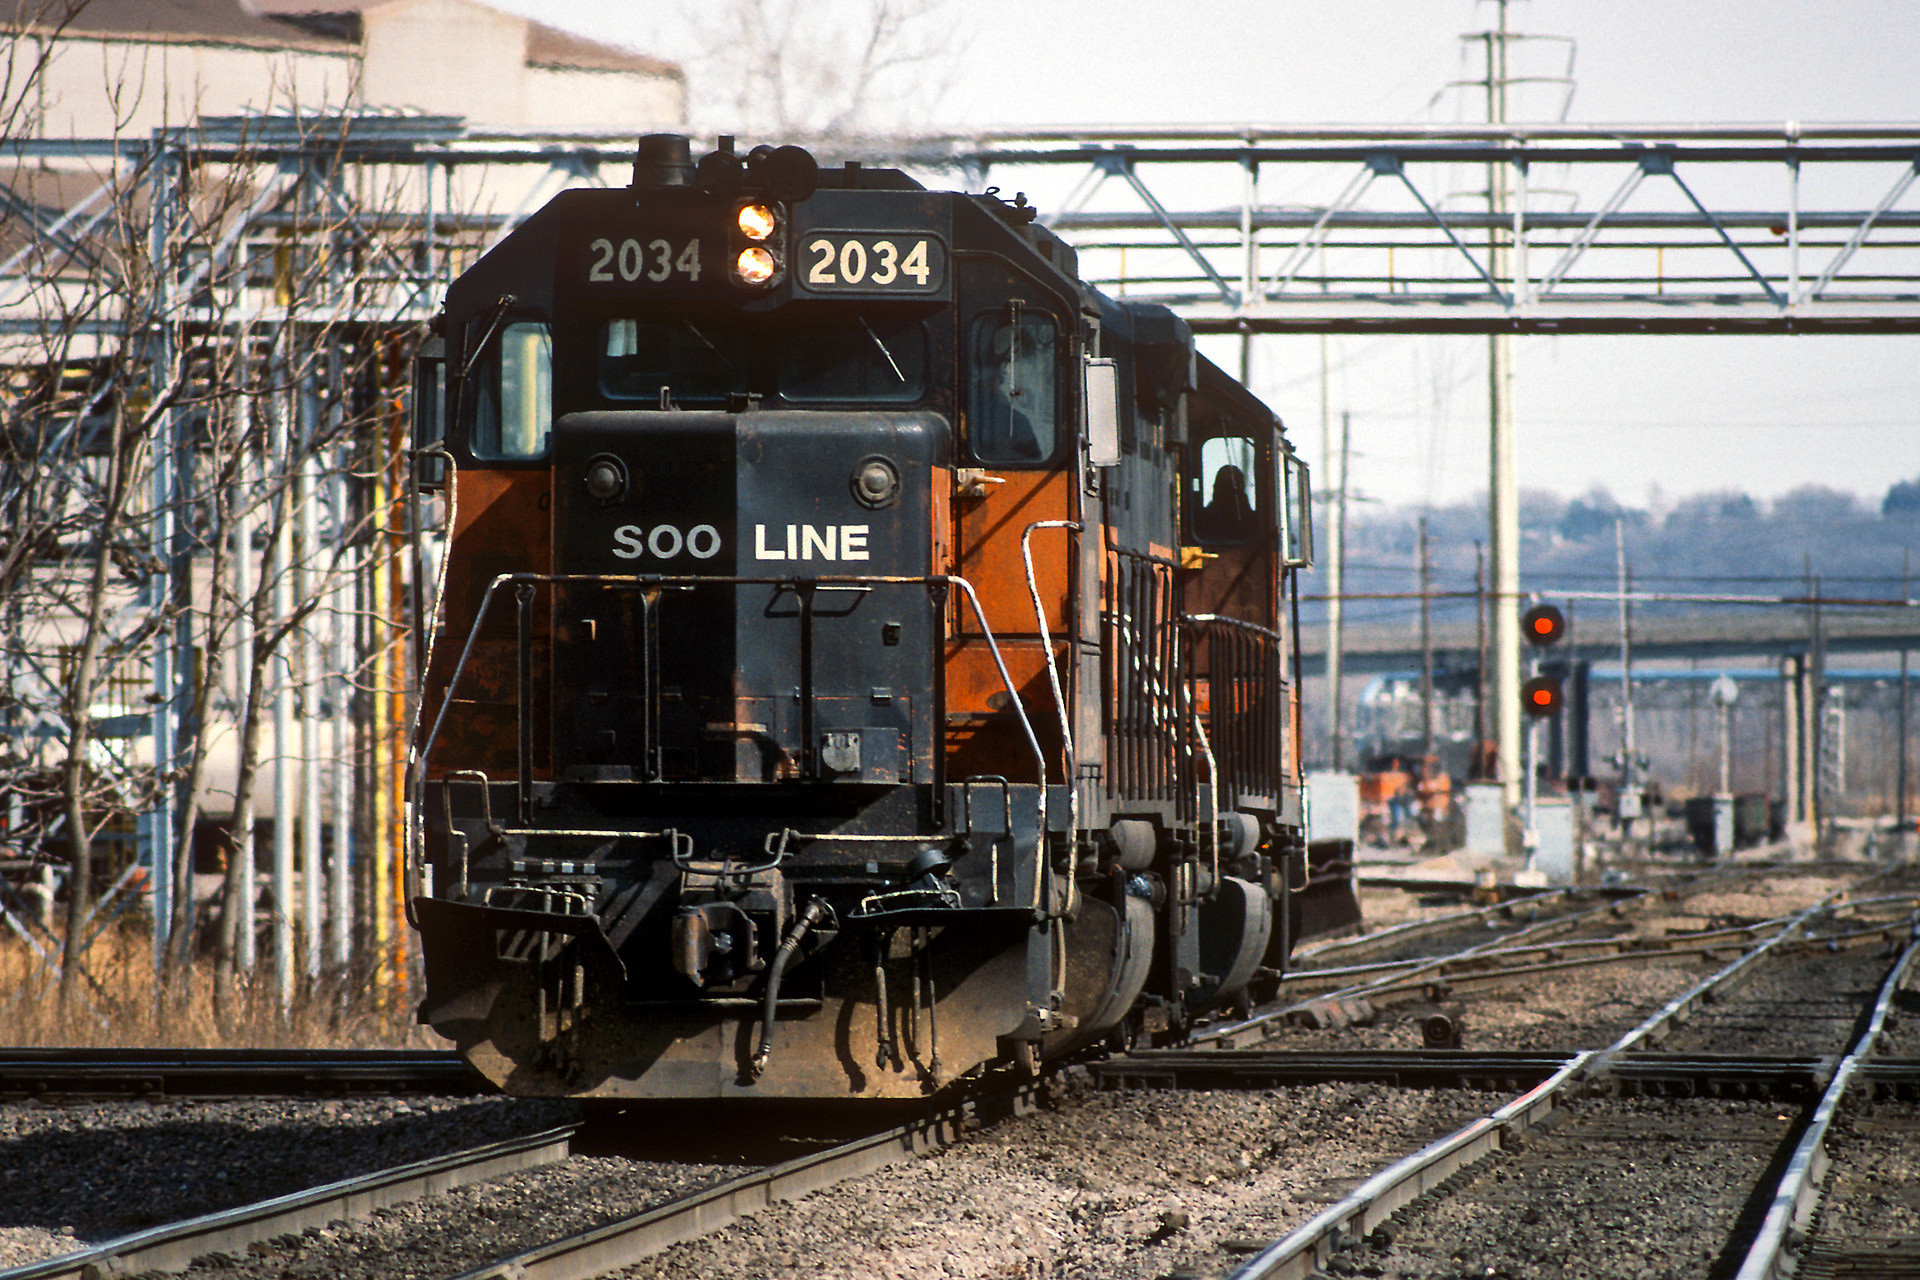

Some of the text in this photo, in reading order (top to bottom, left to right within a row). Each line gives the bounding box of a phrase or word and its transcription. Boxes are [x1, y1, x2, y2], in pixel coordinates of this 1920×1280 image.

[589, 238, 702, 282] 2034
[809, 239, 930, 285] 2034
[612, 523, 870, 560] SOO LINE
